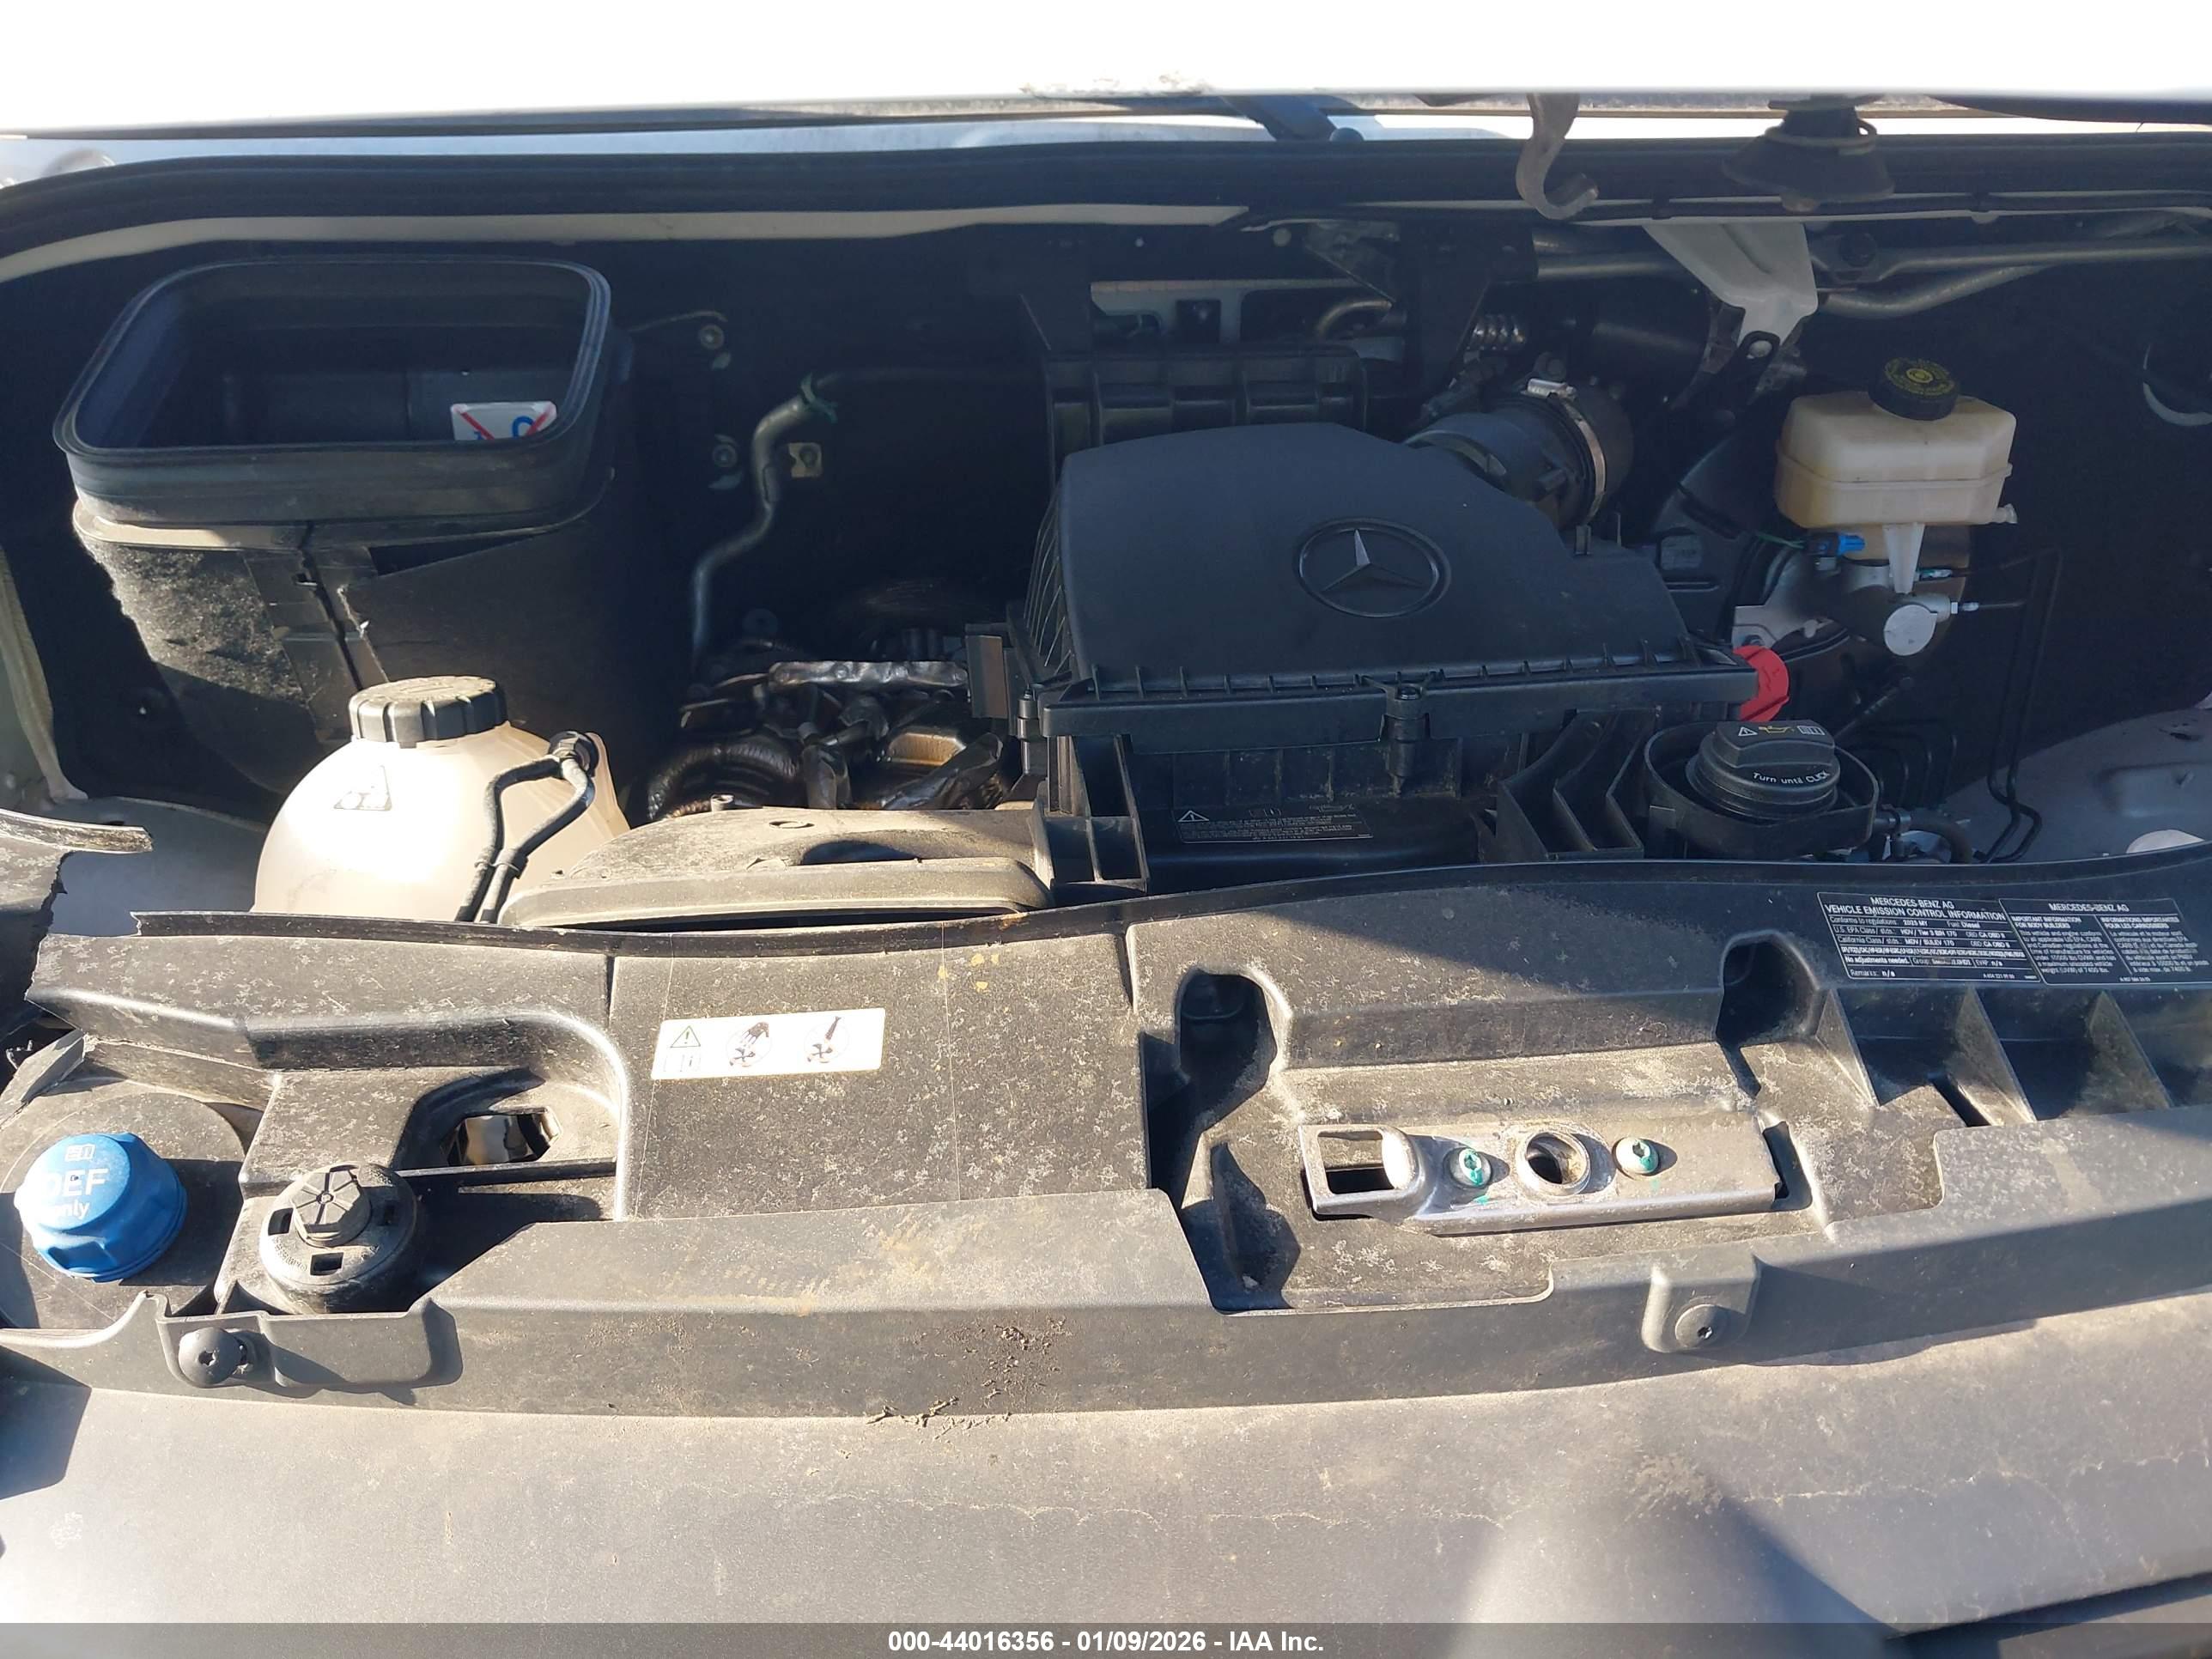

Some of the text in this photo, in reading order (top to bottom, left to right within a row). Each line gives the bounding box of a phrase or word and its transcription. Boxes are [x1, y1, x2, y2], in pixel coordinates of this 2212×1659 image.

[1753, 772, 1777, 783] Turn
[1806, 770, 1830, 782] CLICK
[1870, 896, 1955, 909] MERCEDES-BENZ AG
[2048, 902, 2130, 912] MERCEDES-BENZ AG
[1824, 904, 2007, 921] VEHICLE EMISSION CONTROL INFORMATION
[1837, 935, 1866, 944] California
[1854, 957, 1887, 965] adjustments
[1881, 969, 1896, 978] n/a
[42, 1168, 108, 1197] DEF
